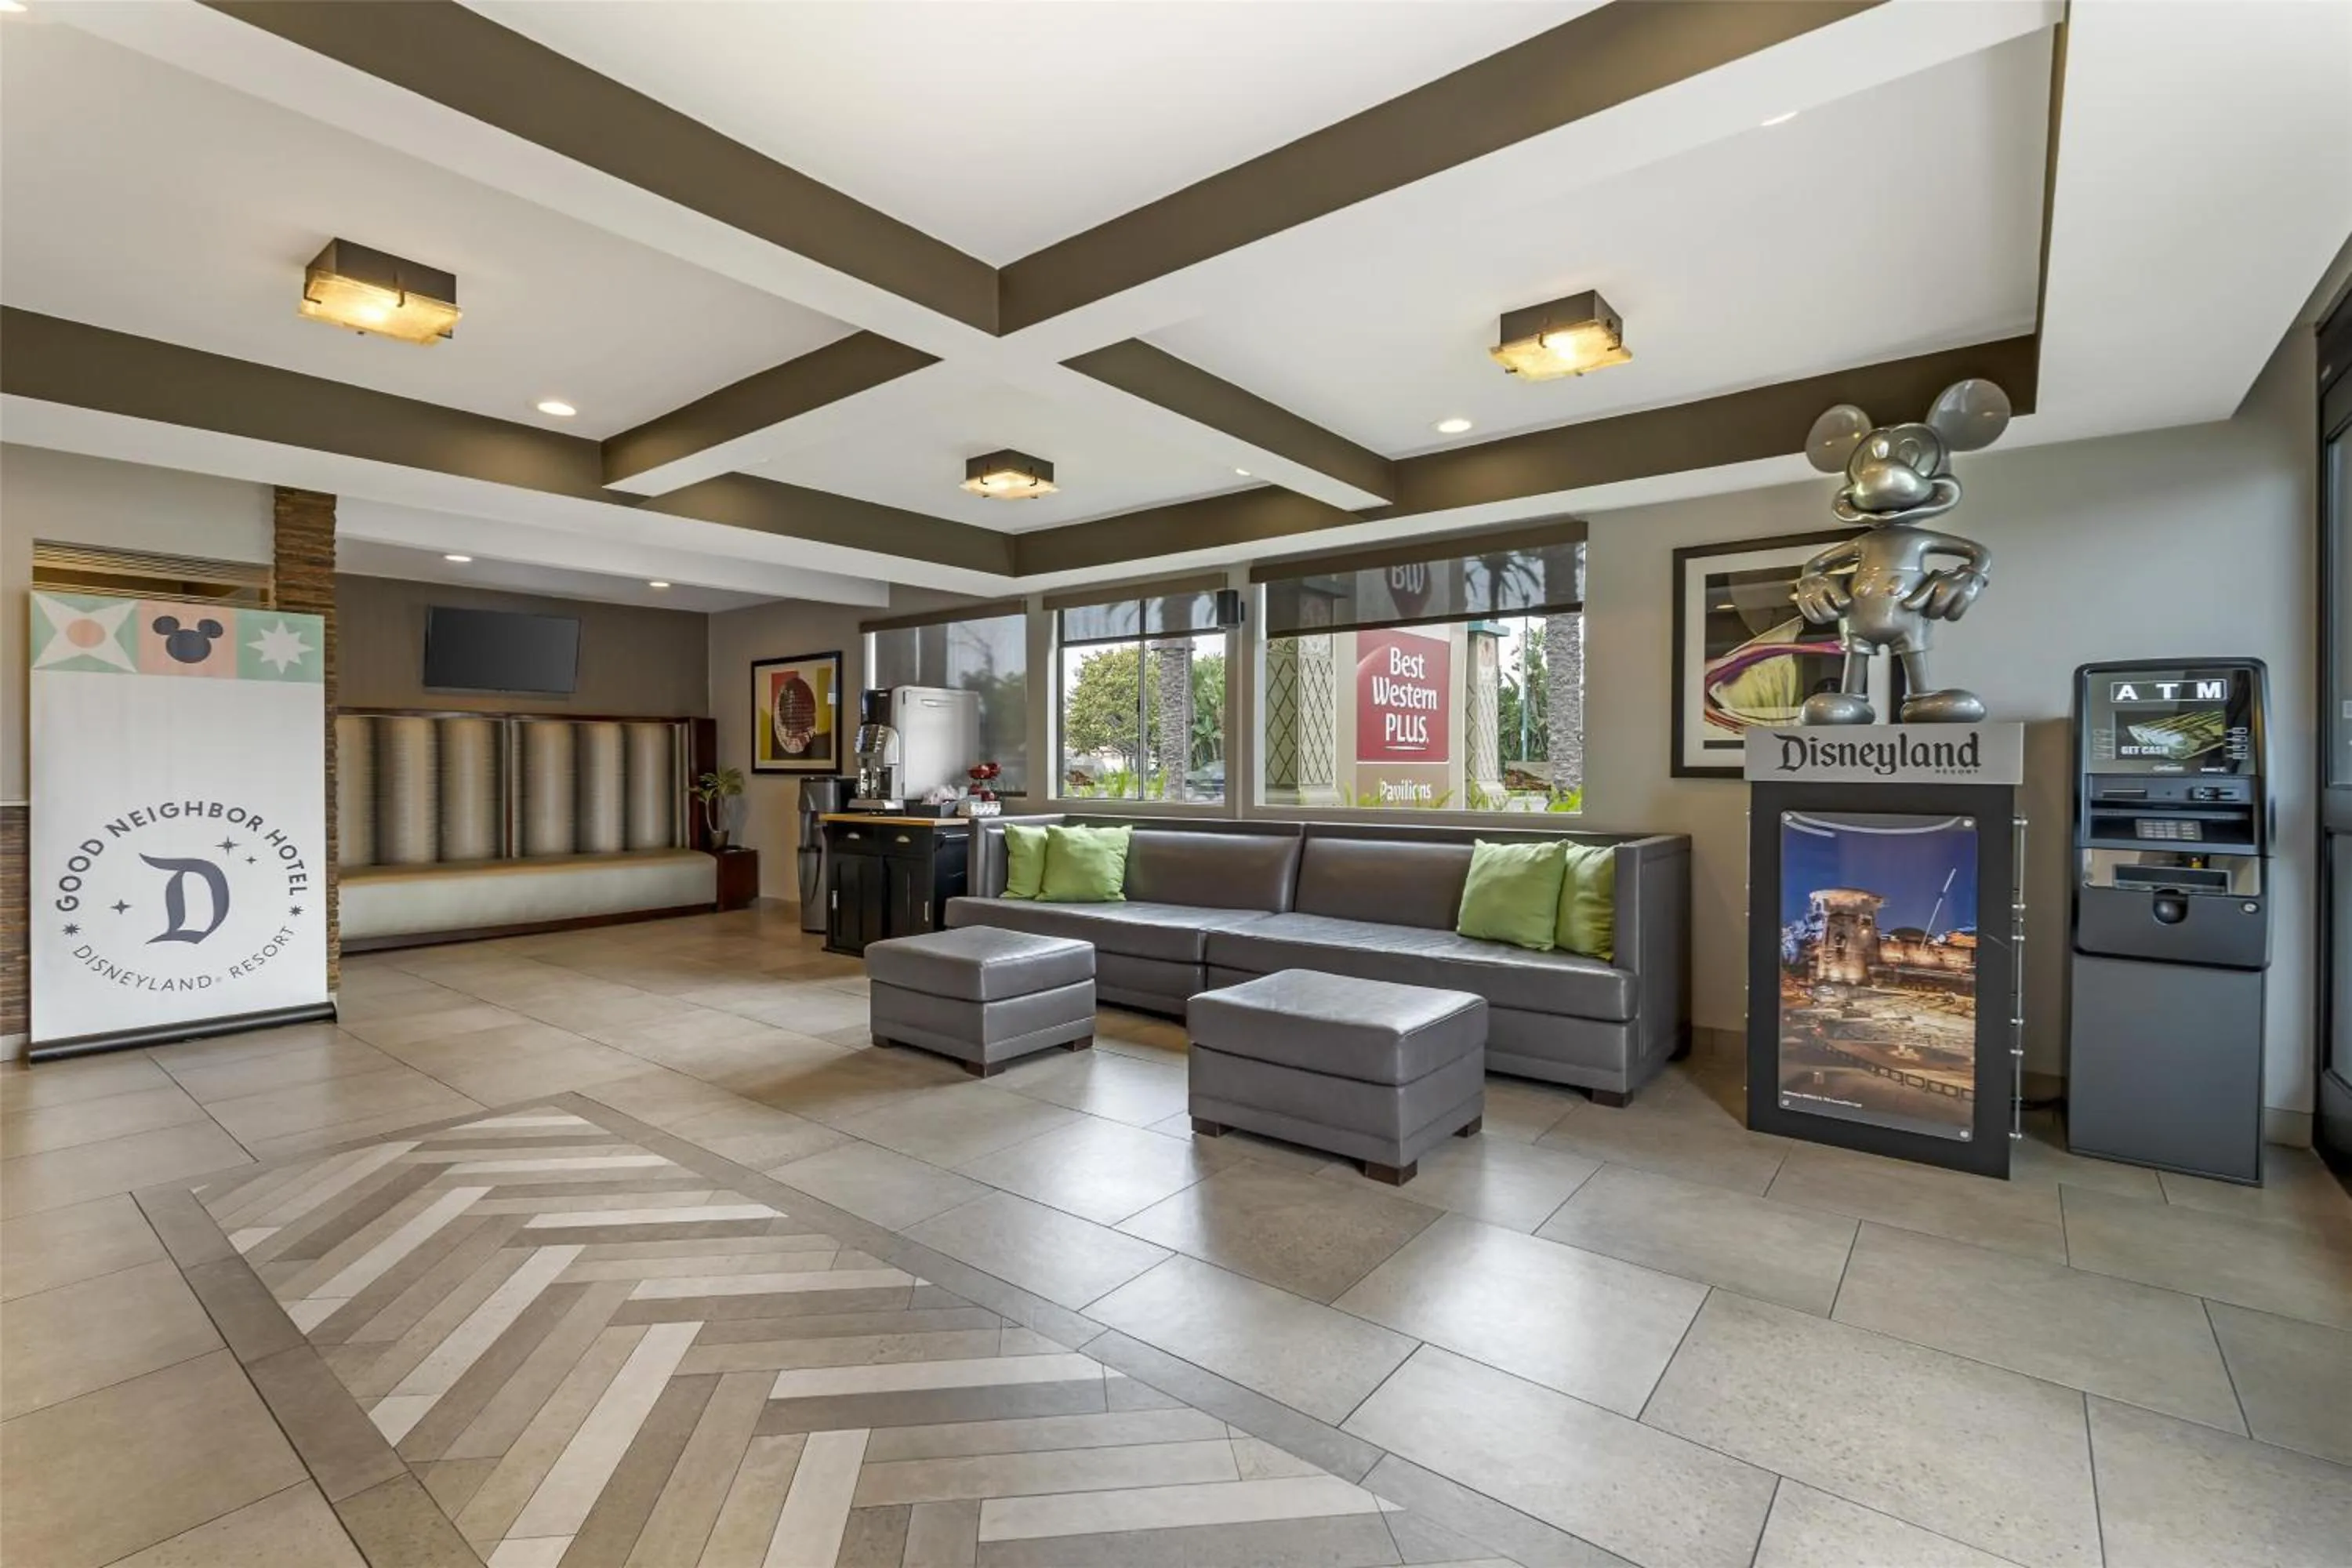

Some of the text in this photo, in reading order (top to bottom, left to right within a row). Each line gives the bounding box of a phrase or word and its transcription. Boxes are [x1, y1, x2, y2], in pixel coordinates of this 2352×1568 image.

[1390, 646, 1425, 680] Best
[1372, 675, 1438, 710] Western
[1773, 732, 1982, 775] Disneyland
[56, 800, 308, 912] GOOD NEIGHBOR HOTEL
[138, 852, 230, 945] D
[73, 925, 296, 992] DISNEYLAND RESORT
